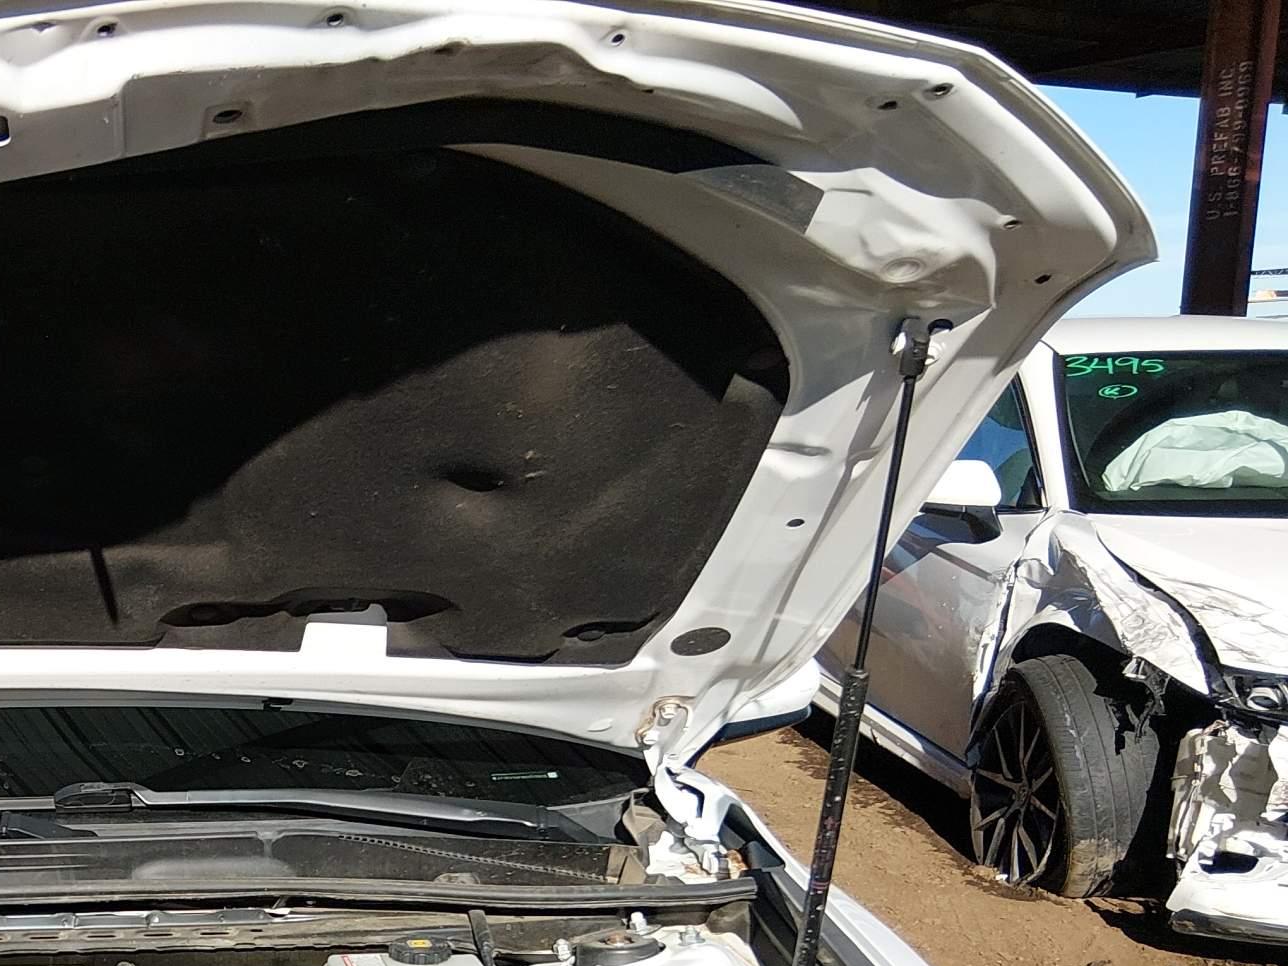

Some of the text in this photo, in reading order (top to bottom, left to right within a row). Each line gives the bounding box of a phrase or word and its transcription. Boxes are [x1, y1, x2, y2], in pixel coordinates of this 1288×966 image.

[1210, 106, 1232, 177] PREFAB
[1205, 184, 1223, 221] U.S.
[1065, 355, 1165, 377] 3495
